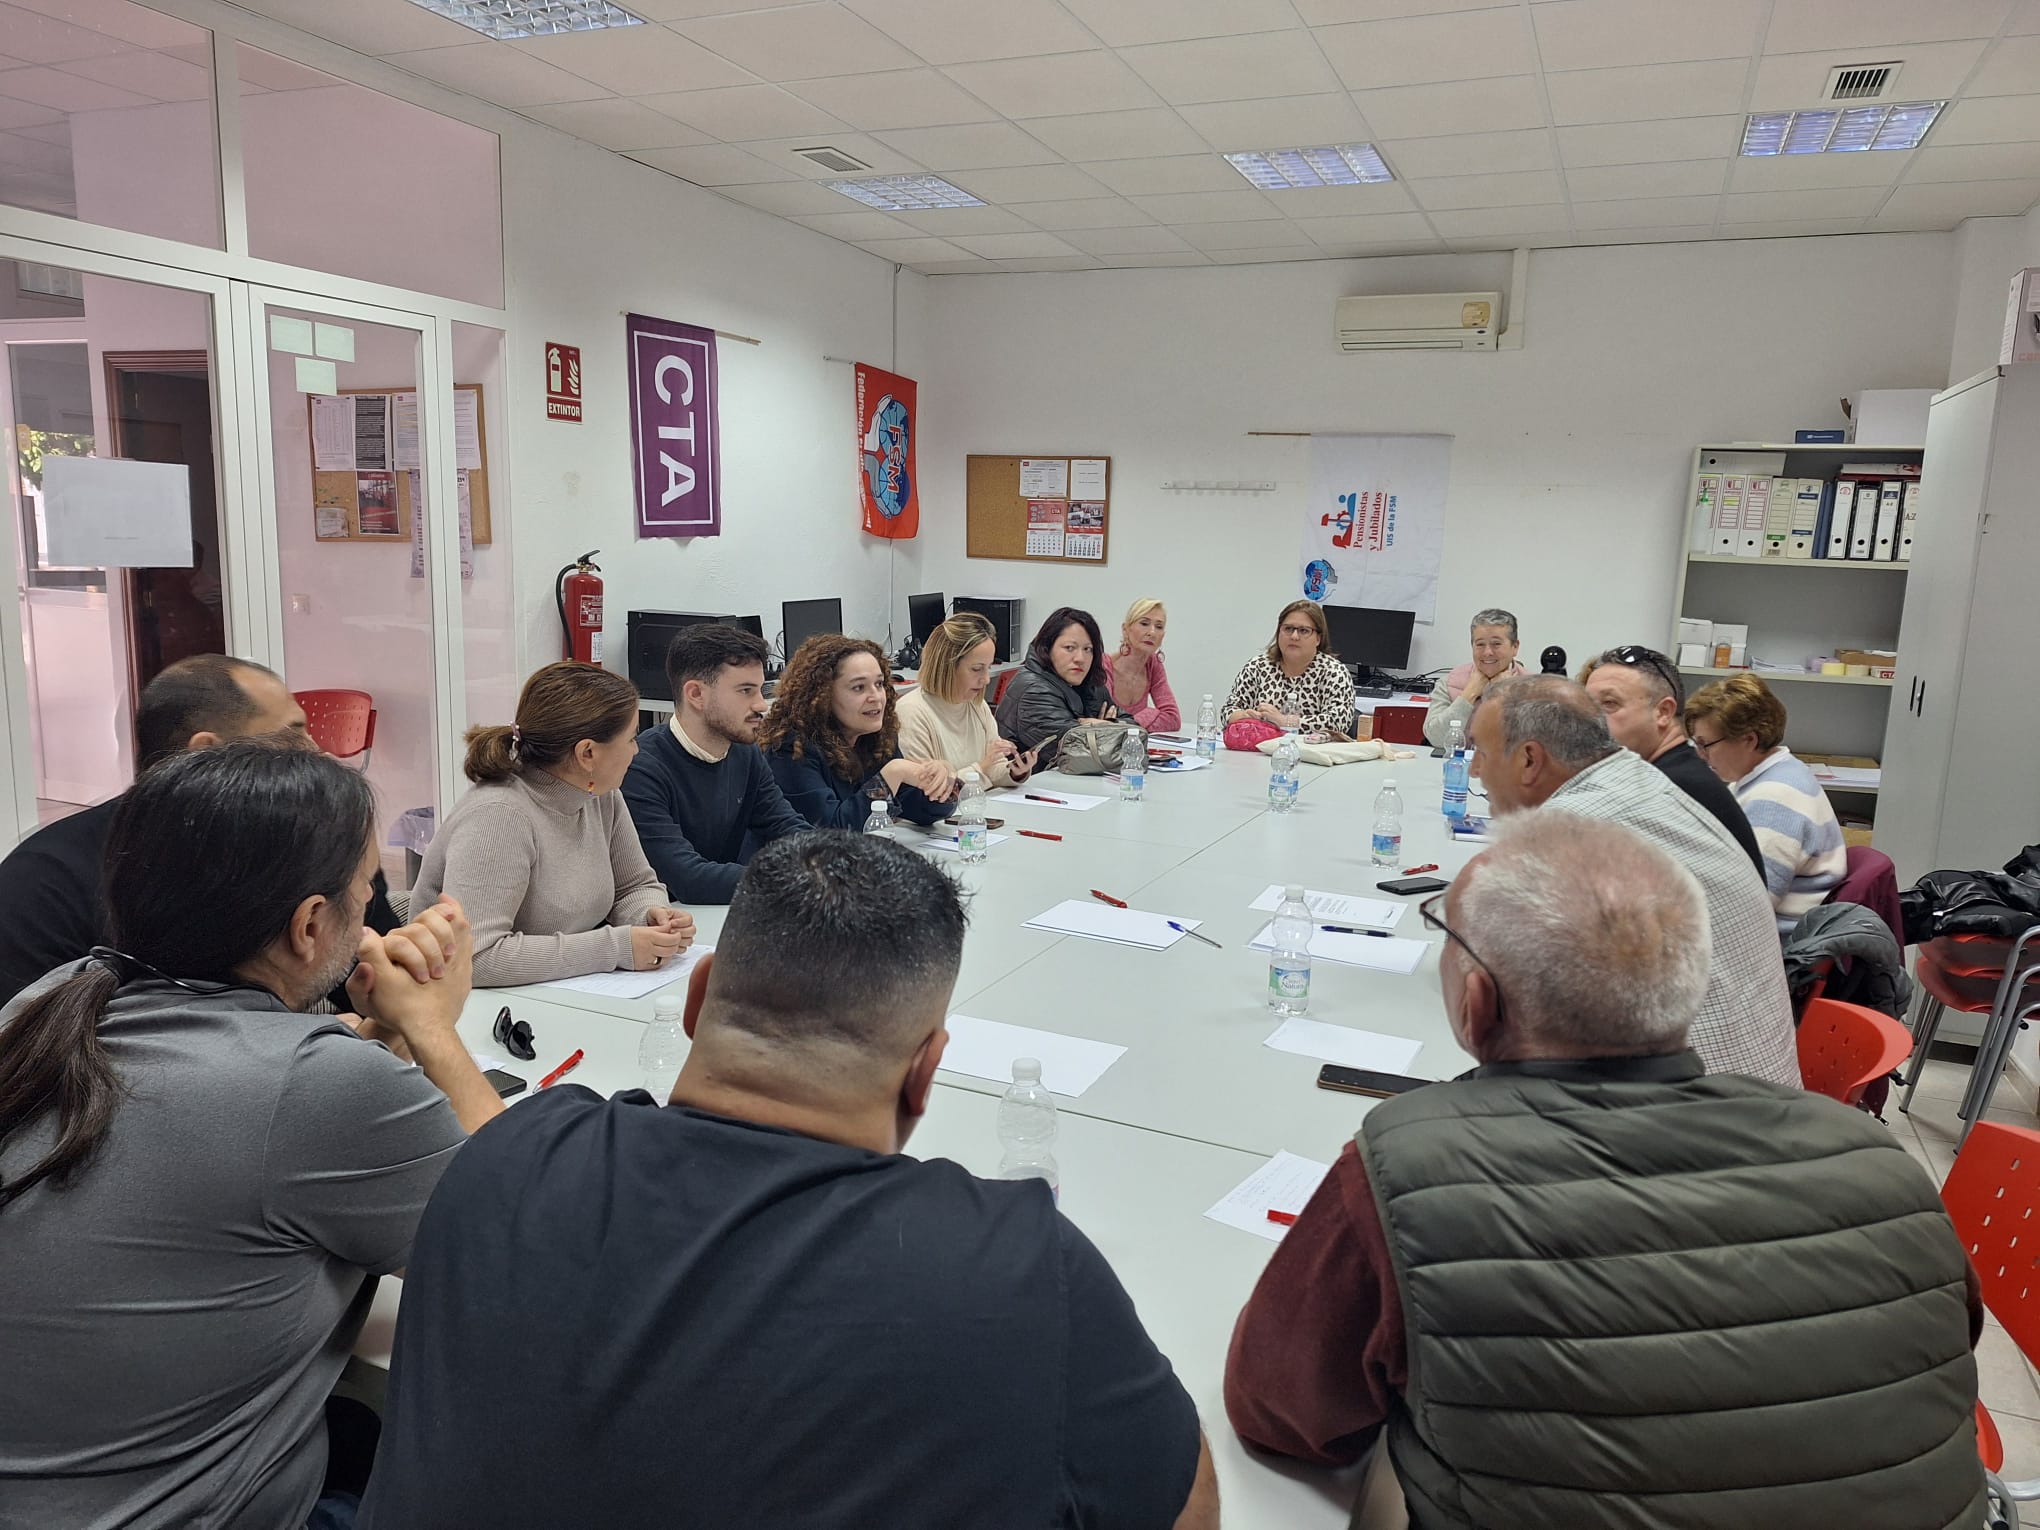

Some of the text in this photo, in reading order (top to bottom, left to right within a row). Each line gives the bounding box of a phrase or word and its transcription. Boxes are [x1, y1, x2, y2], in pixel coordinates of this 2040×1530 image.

[548, 402, 580, 418] EXTINTOR
[654, 354, 696, 507] CTA
[887, 424, 902, 494] FSM
[1353, 491, 1369, 548] Pensionistas
[1369, 492, 1382, 552] y Jubilados
[1388, 513, 1396, 521] la
[1389, 495, 1397, 512] FSM
[1387, 522, 1394, 532] de
